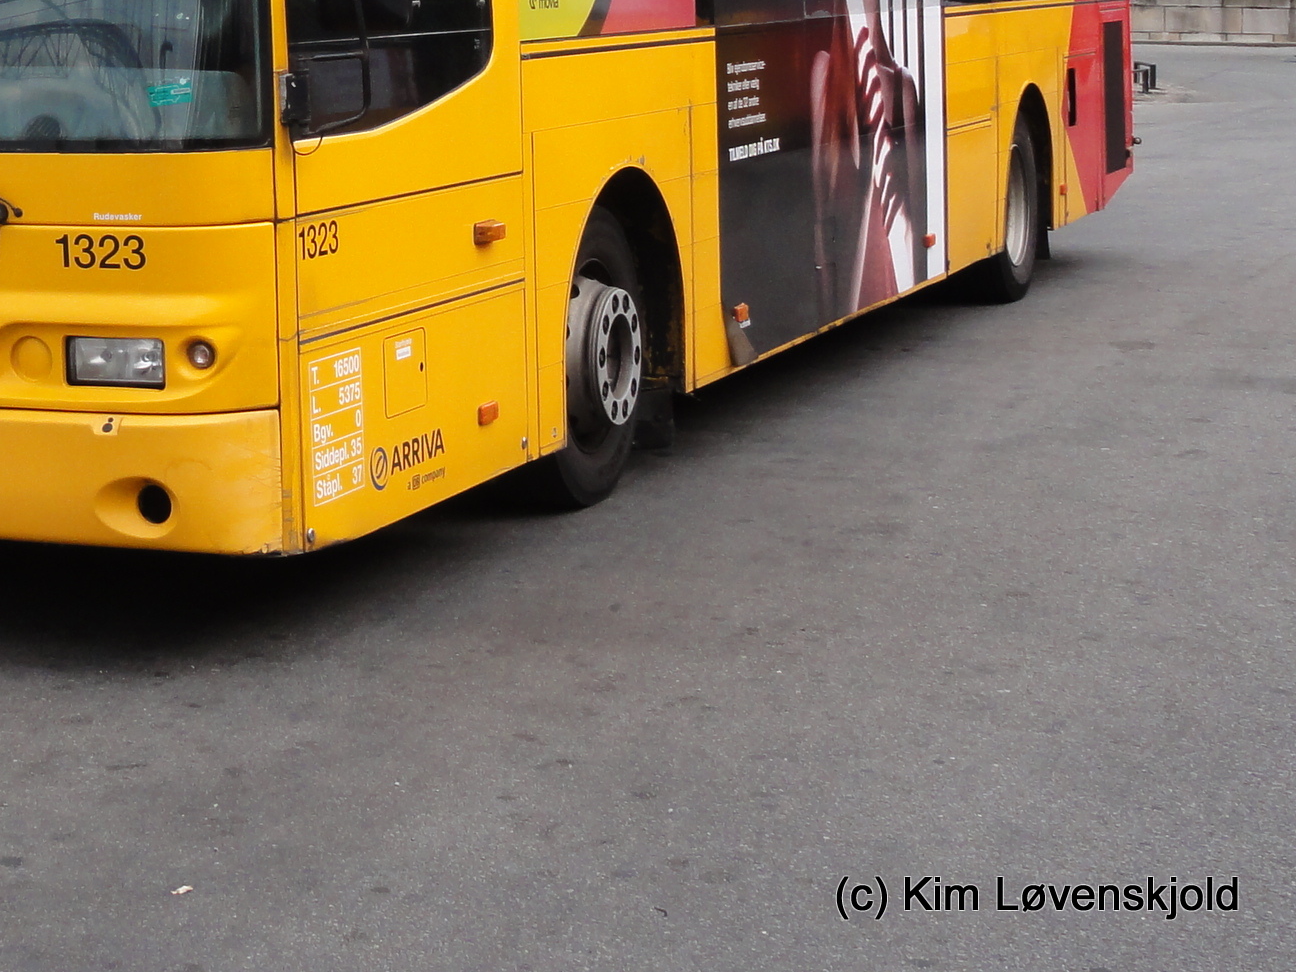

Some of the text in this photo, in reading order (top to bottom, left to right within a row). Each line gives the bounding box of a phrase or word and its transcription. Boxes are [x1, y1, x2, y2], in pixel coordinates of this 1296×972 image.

[55, 234, 147, 270] 1323
[298, 220, 339, 261] 1323
[311, 354, 360, 385] T. 16500
[312, 382, 361, 414] L. 5375
[313, 409, 362, 445] Bgv. 0
[315, 437, 362, 471] Siddepl. 35
[390, 428, 445, 476] ARRIVA
[352, 464, 363, 484] 37
